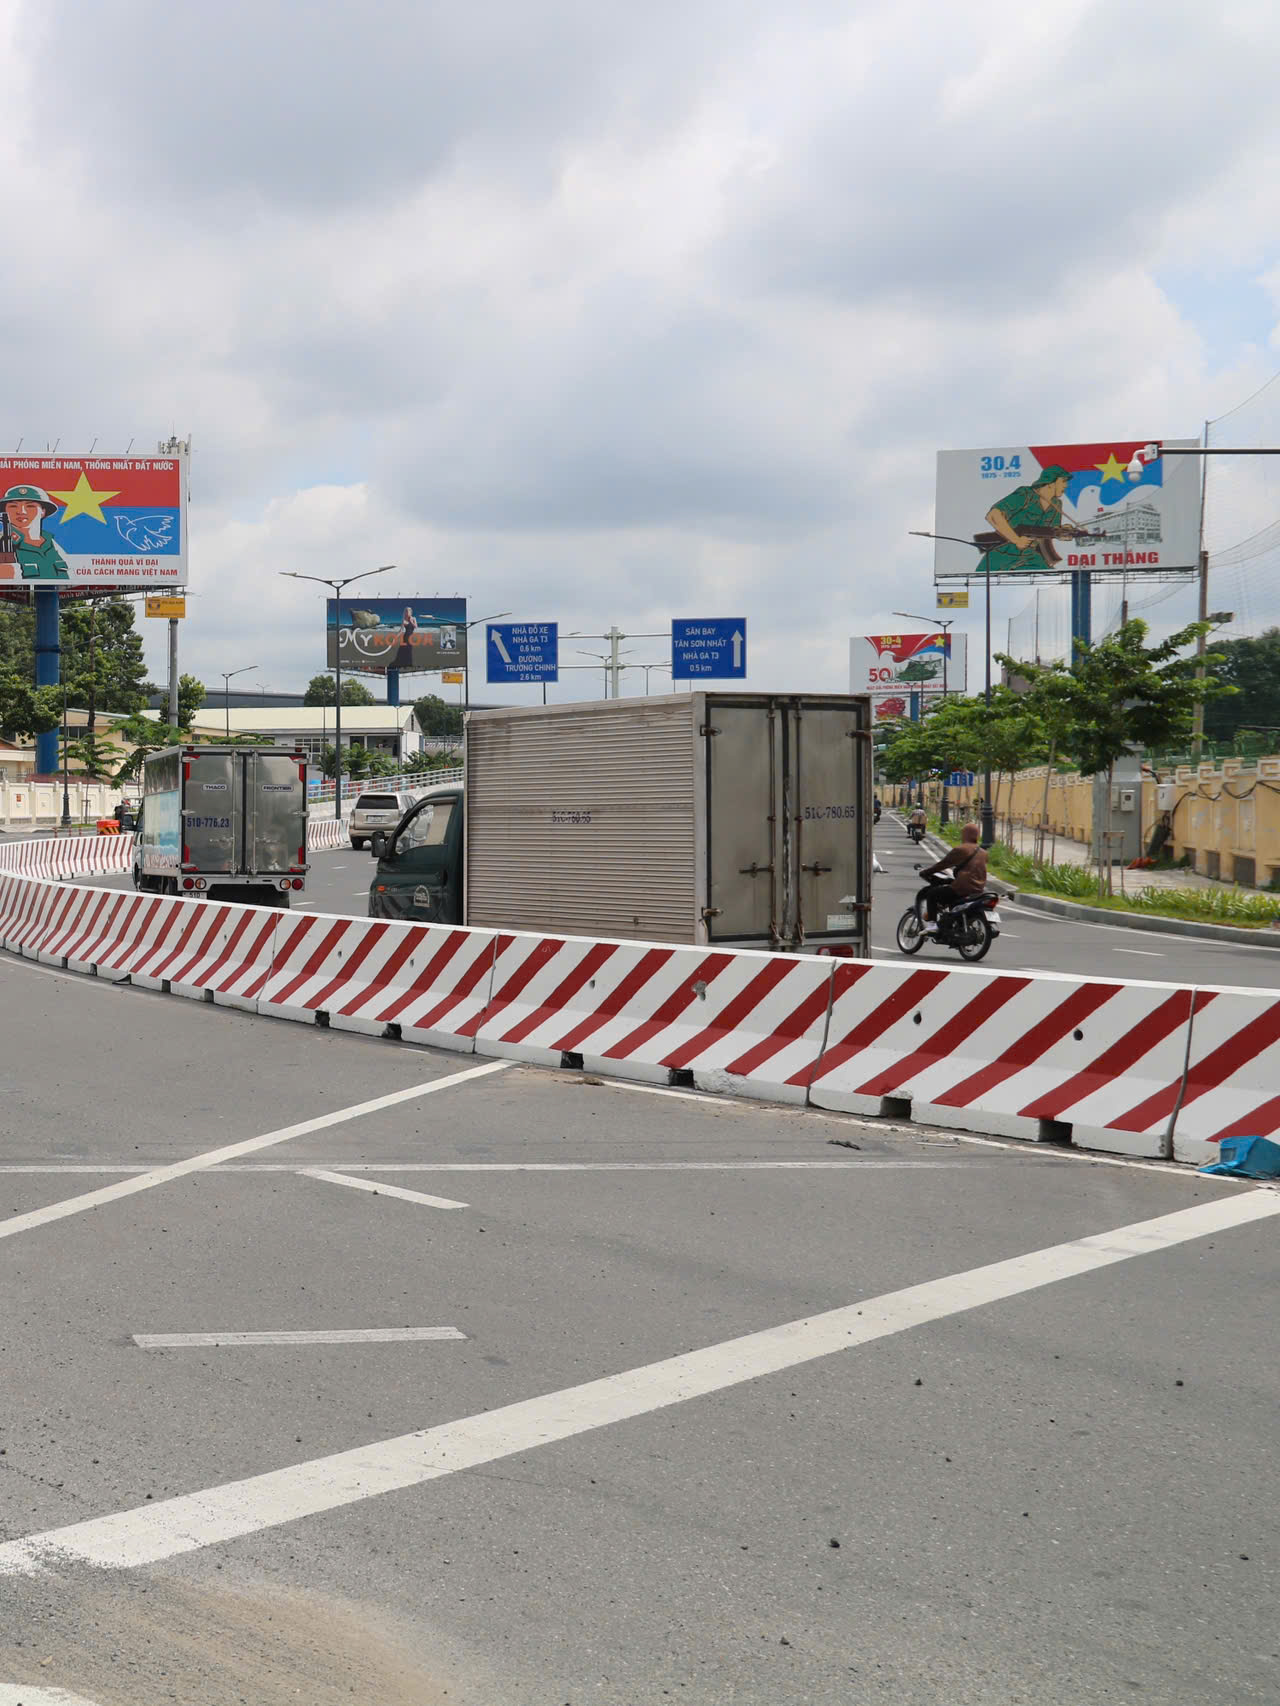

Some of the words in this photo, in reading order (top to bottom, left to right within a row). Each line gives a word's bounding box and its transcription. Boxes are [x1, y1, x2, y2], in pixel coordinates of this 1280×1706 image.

[13, 459, 40, 470] PHÓNG
[41, 459, 62, 470] MIỀN
[63, 460, 83, 471] NAM,
[85, 459, 111, 470] THỐNG
[113, 459, 133, 471] NHẤT
[135, 460, 152, 471] ĐẤT
[153, 460, 174, 471] NƯỚC
[981, 455, 1022, 471] 30.4
[1067, 553, 1096, 568] ĐẠI
[1101, 549, 1159, 565] THẮNG
[539, 626, 548, 634] XE
[702, 627, 716, 635] BAY
[529, 635, 538, 643] GA
[540, 635, 548, 643] T3
[880, 636, 902, 645] 30-4
[682, 651, 698, 660] NHÀ
[690, 664, 700, 672] 0.5
[868, 667, 892, 682] 50
